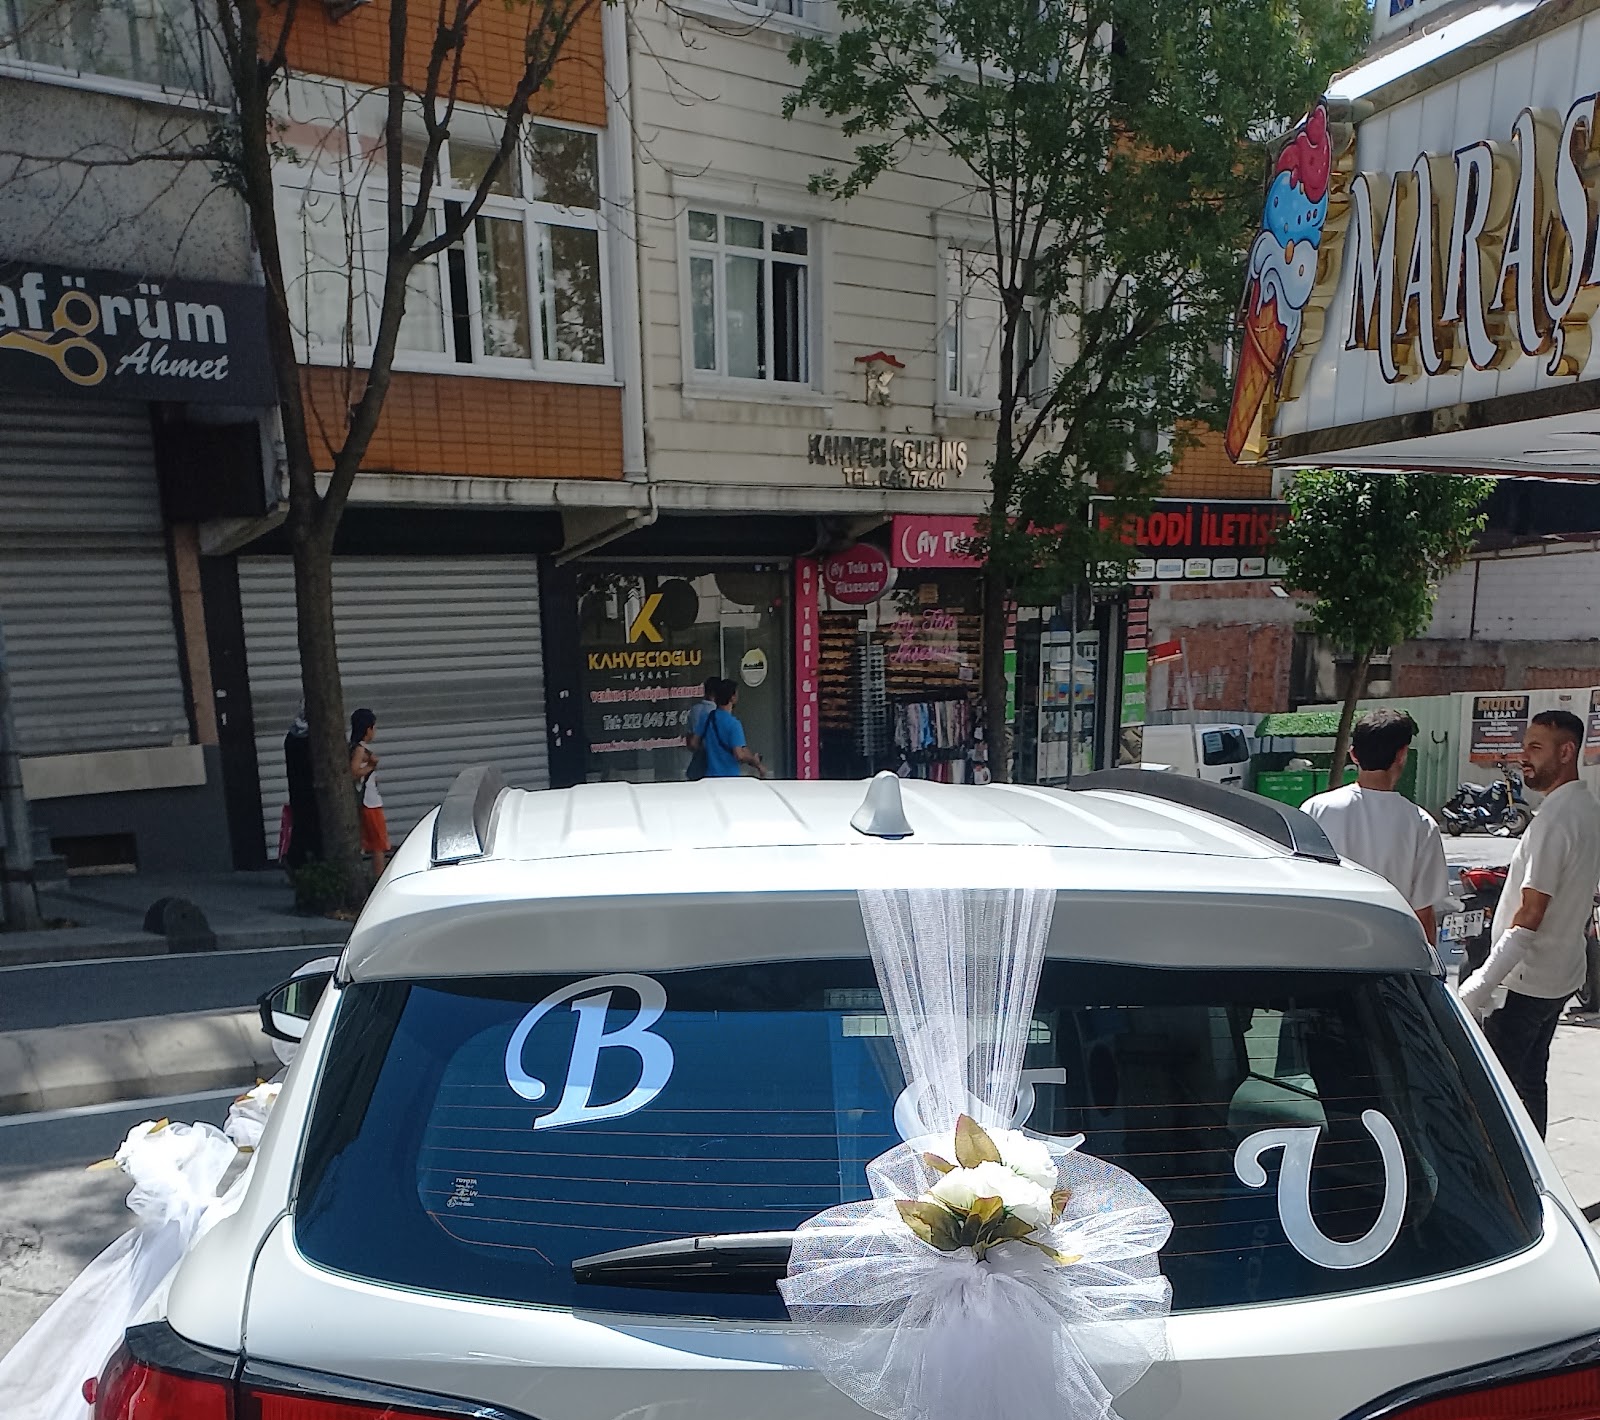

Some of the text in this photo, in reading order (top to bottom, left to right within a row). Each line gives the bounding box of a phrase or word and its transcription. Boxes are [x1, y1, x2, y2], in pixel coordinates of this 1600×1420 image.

[1345, 92, 1600, 385] MARAŞ
[115, 341, 229, 381] Ahmet
[1201, 504, 1290, 555] İLETİŞİ
[504, 973, 675, 1131] B
[1234, 1108, 1410, 1270] U
